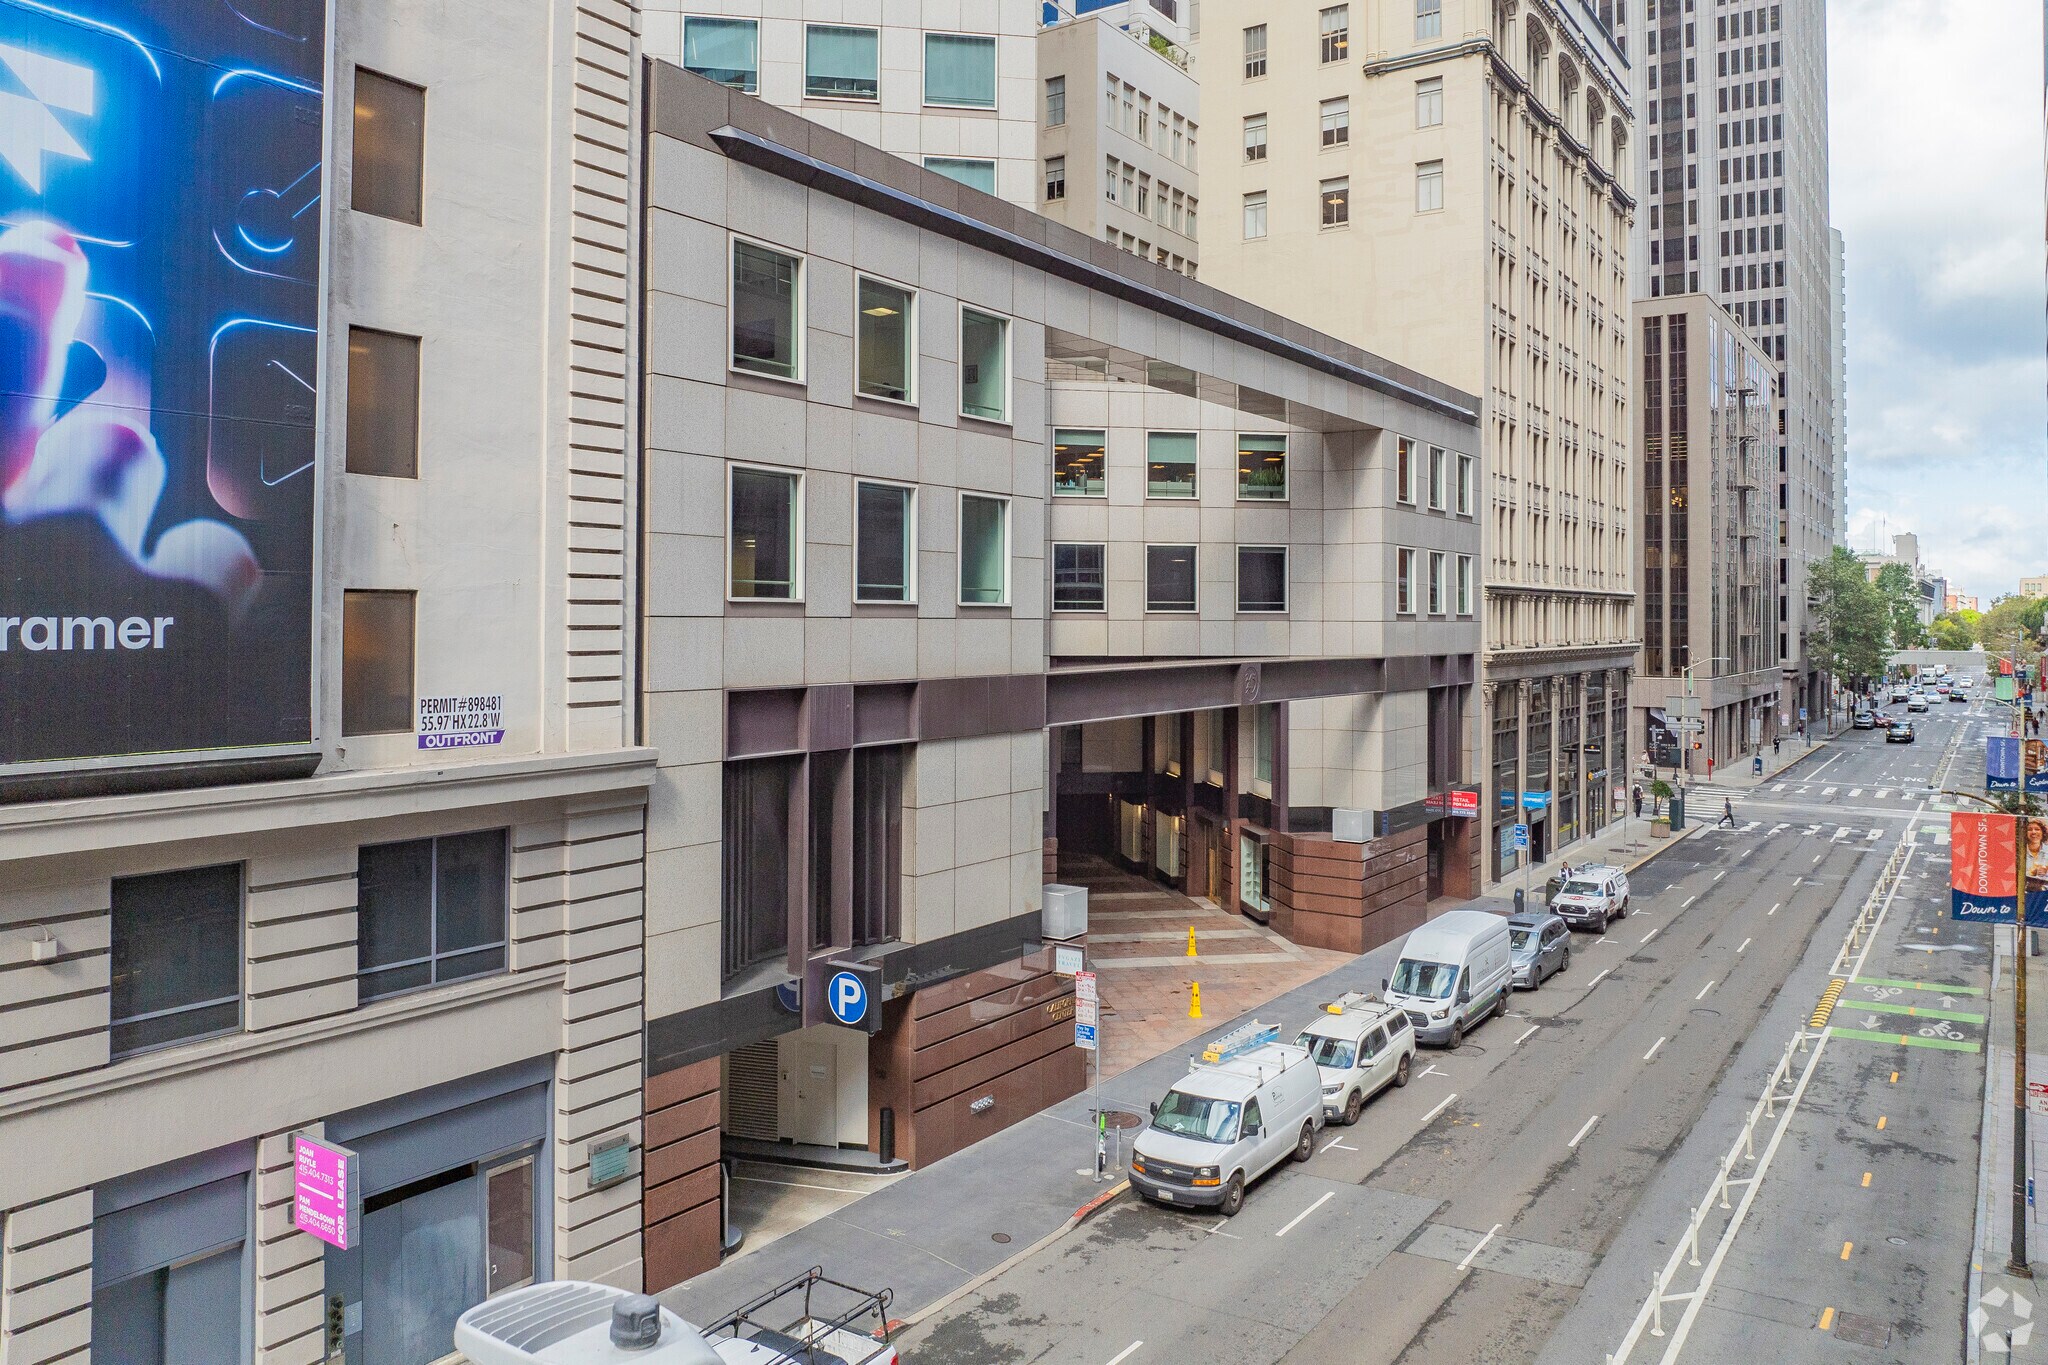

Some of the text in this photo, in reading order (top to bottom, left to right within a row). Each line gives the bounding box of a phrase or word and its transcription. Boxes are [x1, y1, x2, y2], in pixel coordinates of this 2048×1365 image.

[0, 615, 175, 651] ramer
[420, 696, 502, 714] PERMIT#898481
[425, 731, 498, 748] OUTFRONT
[1978, 834, 1988, 894] DOWNTOWN
[1960, 902, 2011, 915] Down to
[838, 977, 861, 1016] P
[299, 1145, 314, 1157] JOAN
[299, 1154, 316, 1168] RUYLE
[299, 1194, 311, 1206] PAM
[337, 1158, 345, 1244] FOR LEASE
[299, 1203, 335, 1226] MENDELSOHN
